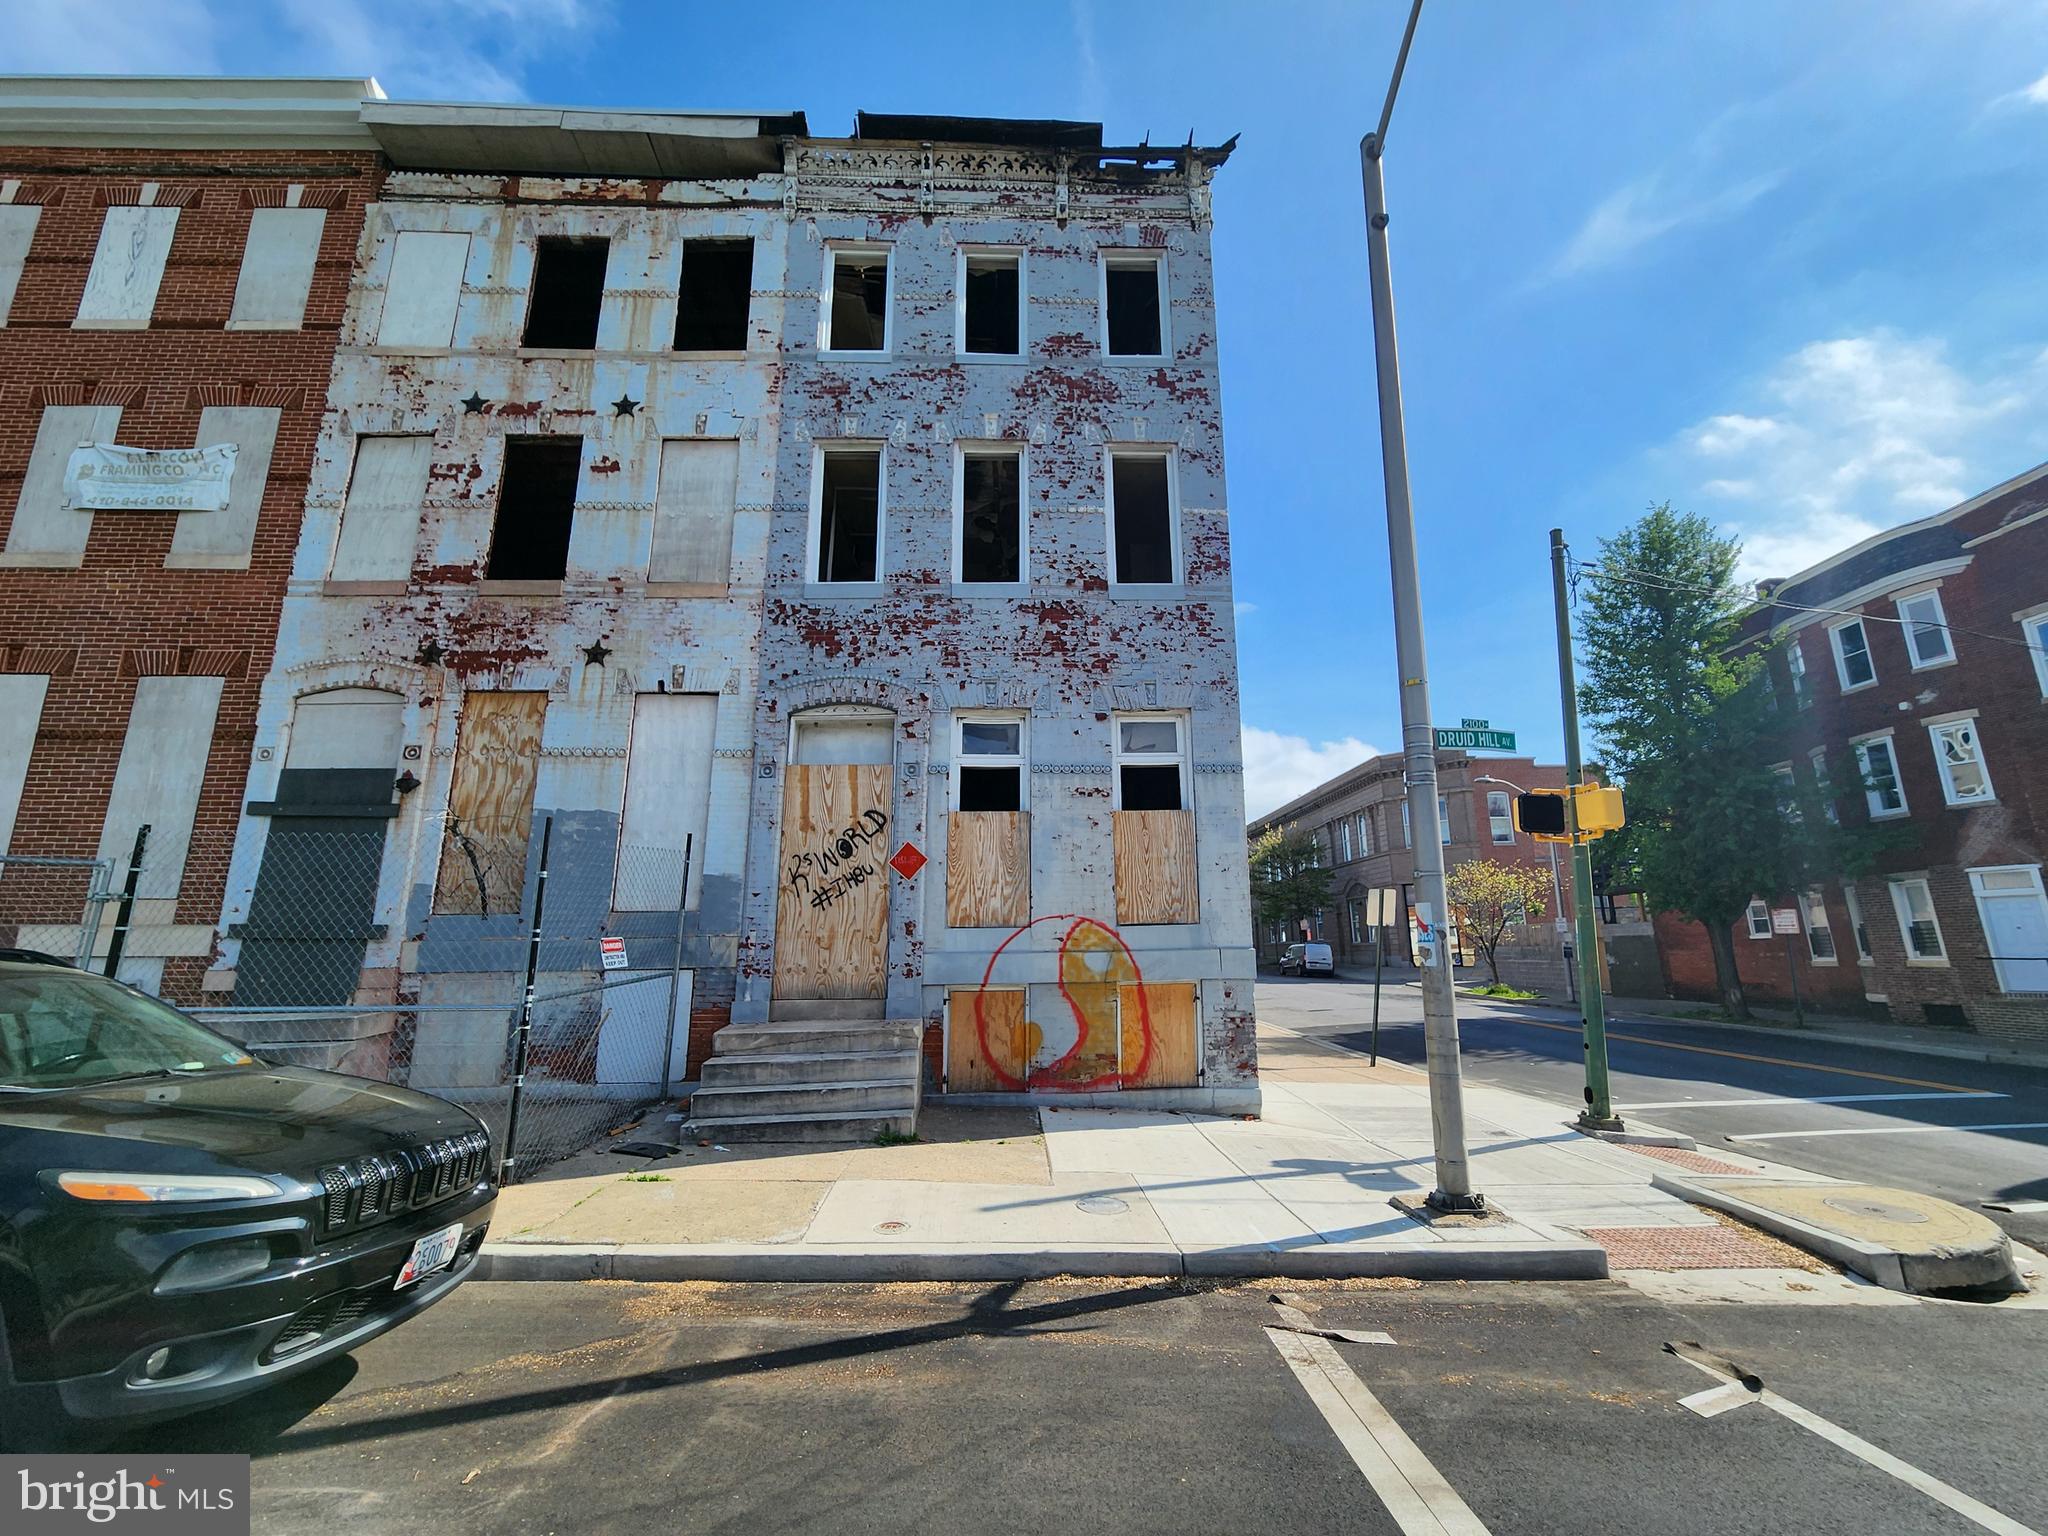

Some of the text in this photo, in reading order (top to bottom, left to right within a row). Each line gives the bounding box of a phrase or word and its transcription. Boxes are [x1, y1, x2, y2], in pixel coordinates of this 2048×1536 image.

[99, 464, 162, 477] FRAMING
[1463, 720, 1485, 729] 2100
[1440, 732, 1475, 746] DRUID
[1479, 733, 1500, 747] HILL
